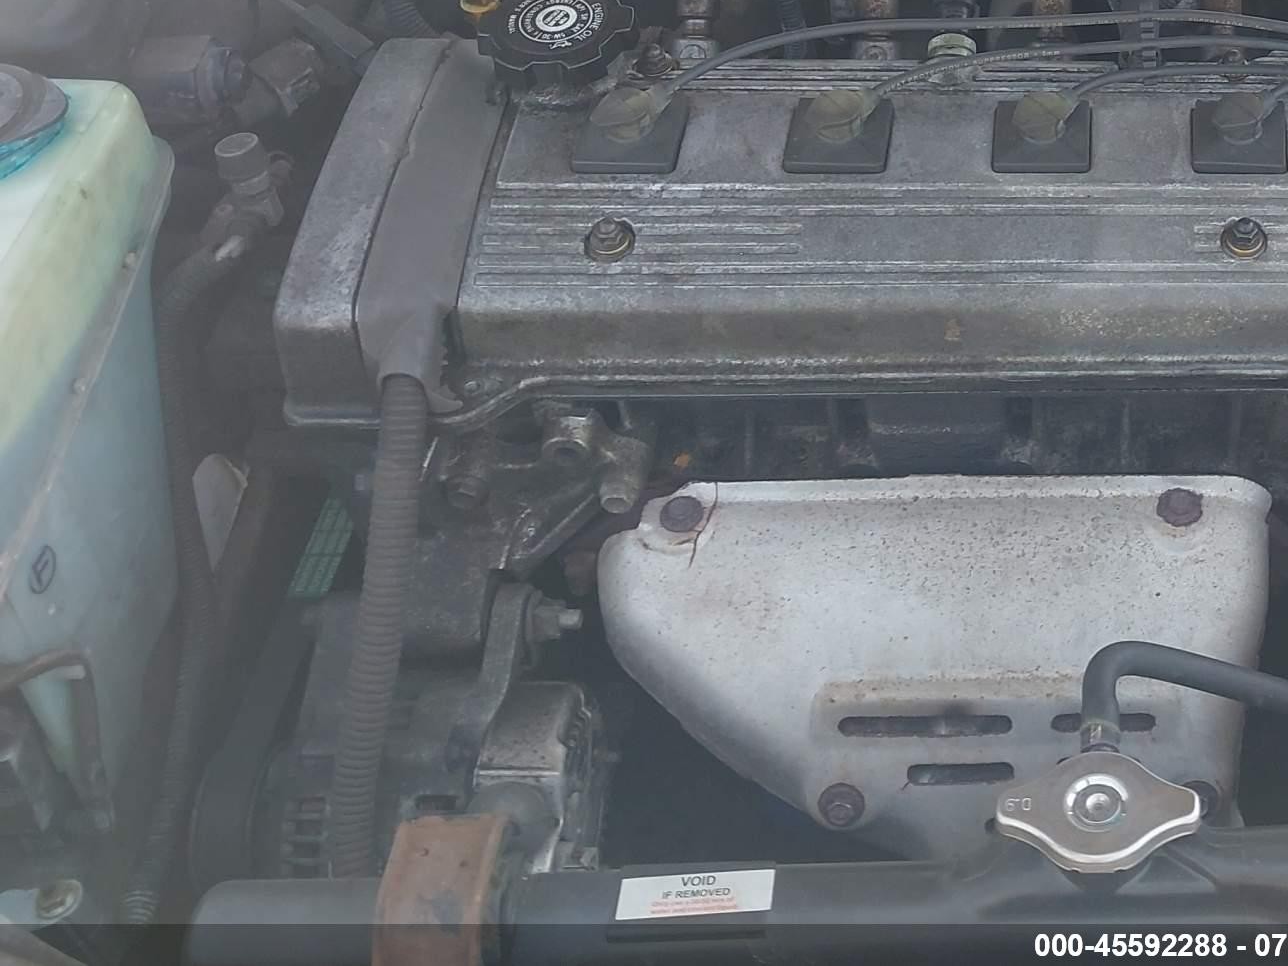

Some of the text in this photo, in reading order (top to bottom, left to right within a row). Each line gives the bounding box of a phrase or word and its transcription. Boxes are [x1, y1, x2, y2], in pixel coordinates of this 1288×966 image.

[574, 2, 605, 42] ENGINE OIL
[681, 875, 717, 887] VOID
[662, 887, 731, 899] IF REMOVED
